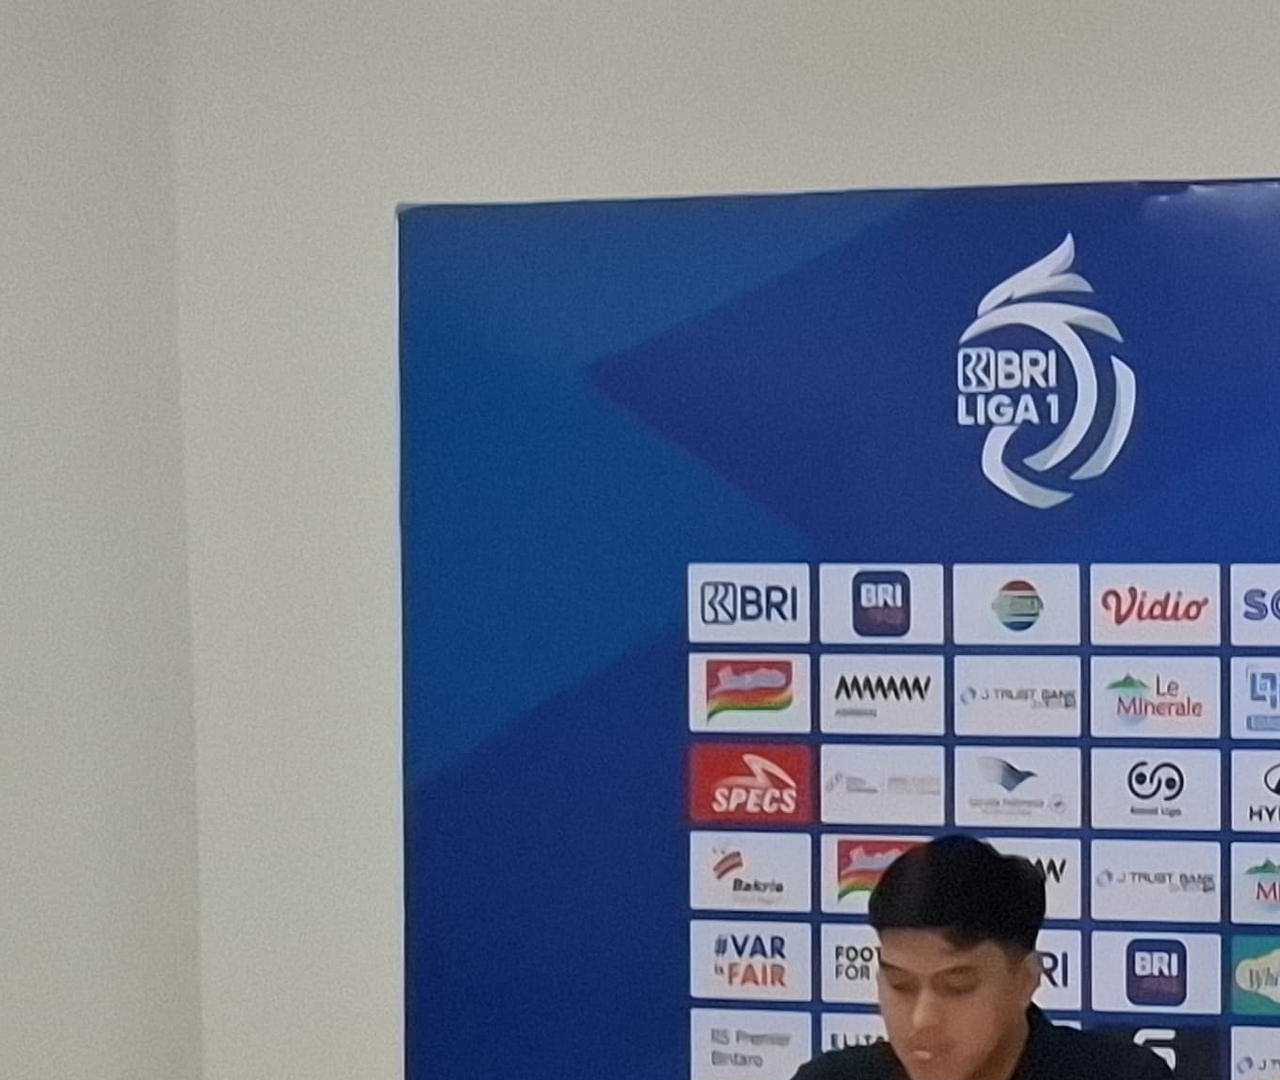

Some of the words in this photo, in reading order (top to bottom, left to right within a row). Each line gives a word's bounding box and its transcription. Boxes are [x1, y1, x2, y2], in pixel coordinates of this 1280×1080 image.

[997, 350, 1055, 389] BRI
[958, 394, 1039, 425] LIGA
[1047, 394, 1059, 424] 1
[741, 583, 798, 621] BRI
[860, 583, 901, 607] BRI
[1101, 587, 1208, 624] Vidio
[1155, 674, 1178, 698] Le
[1117, 695, 1202, 717] Minerale
[712, 785, 796, 813] SPECS
[1128, 872, 1173, 885] TRUST
[714, 936, 785, 961] #VAR
[728, 964, 785, 988] FAIR
[1135, 953, 1178, 976] BRI
